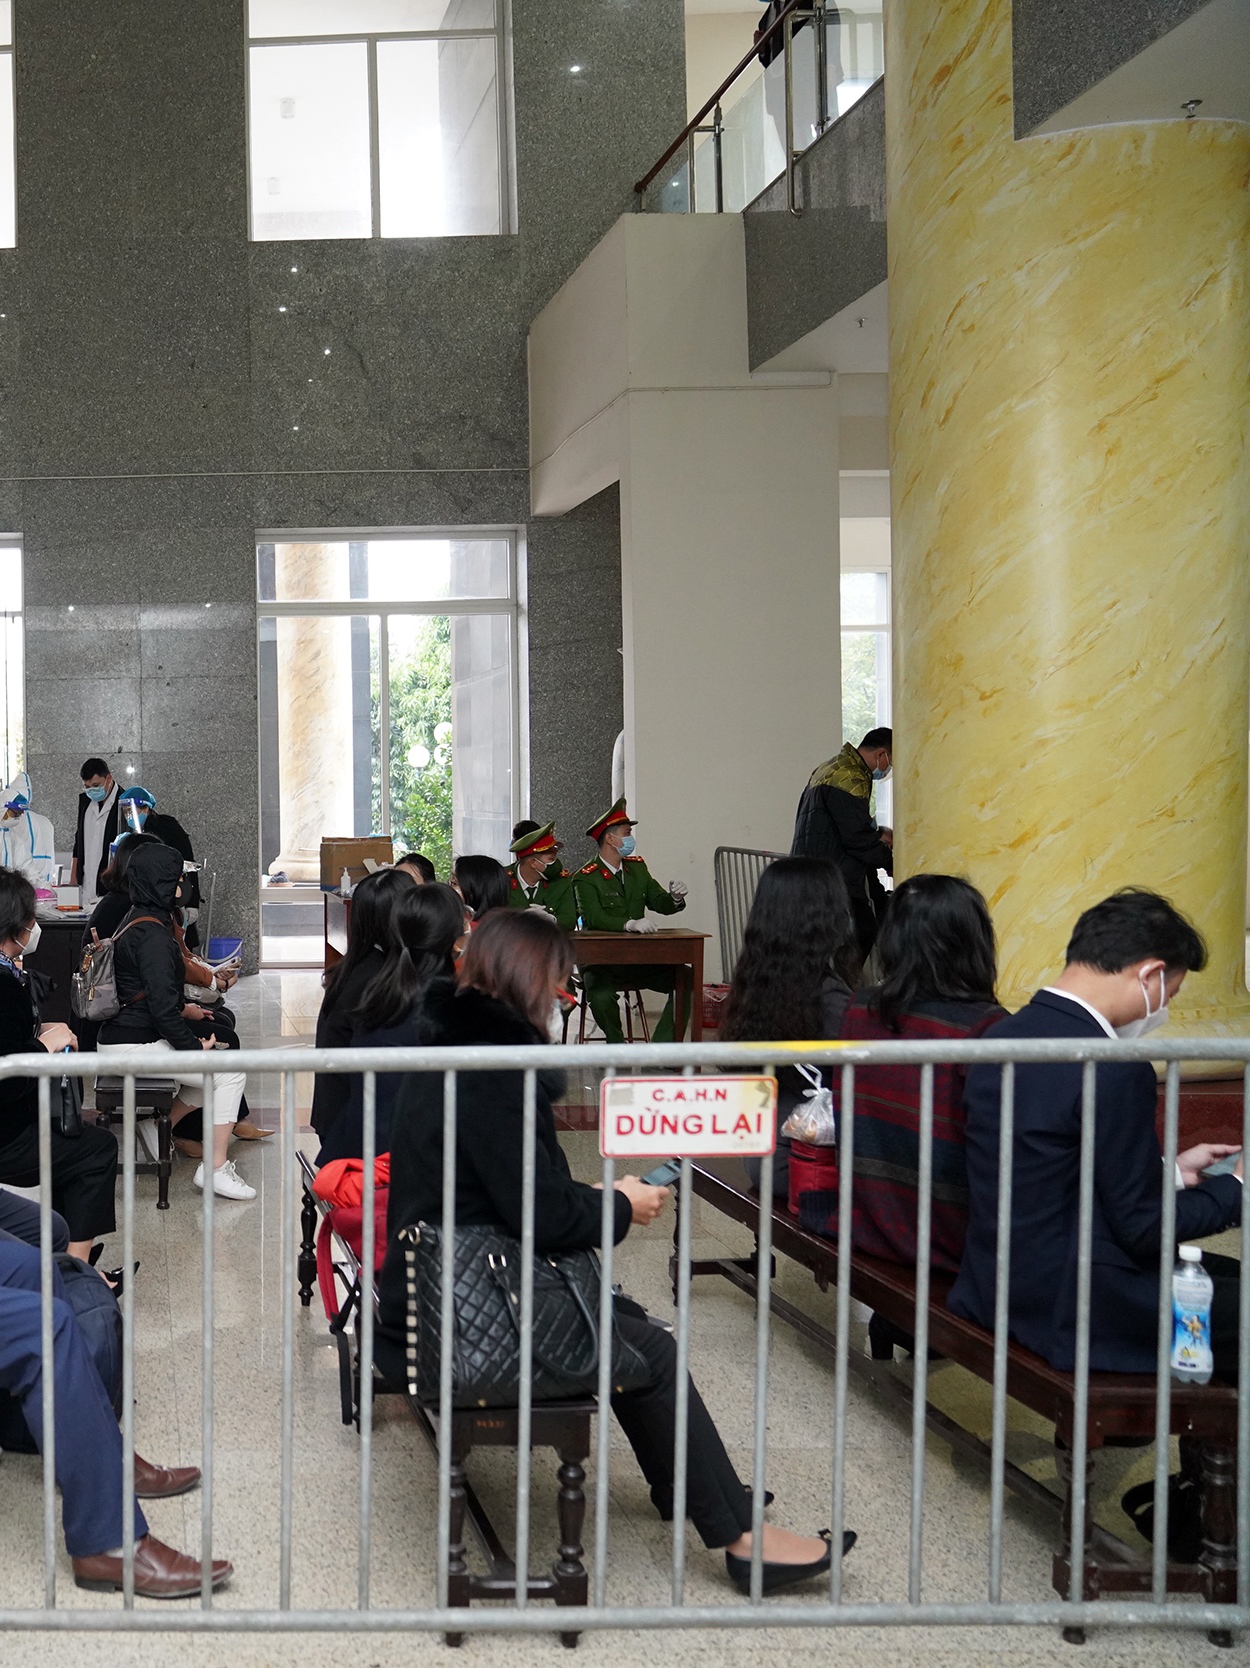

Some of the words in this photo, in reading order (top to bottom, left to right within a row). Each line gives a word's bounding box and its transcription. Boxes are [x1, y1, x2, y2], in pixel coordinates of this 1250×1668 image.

[652, 1089, 728, 1102] C.A.H.N
[615, 1107, 704, 1136] DỪNG
[711, 1112, 762, 1140] LẠI
